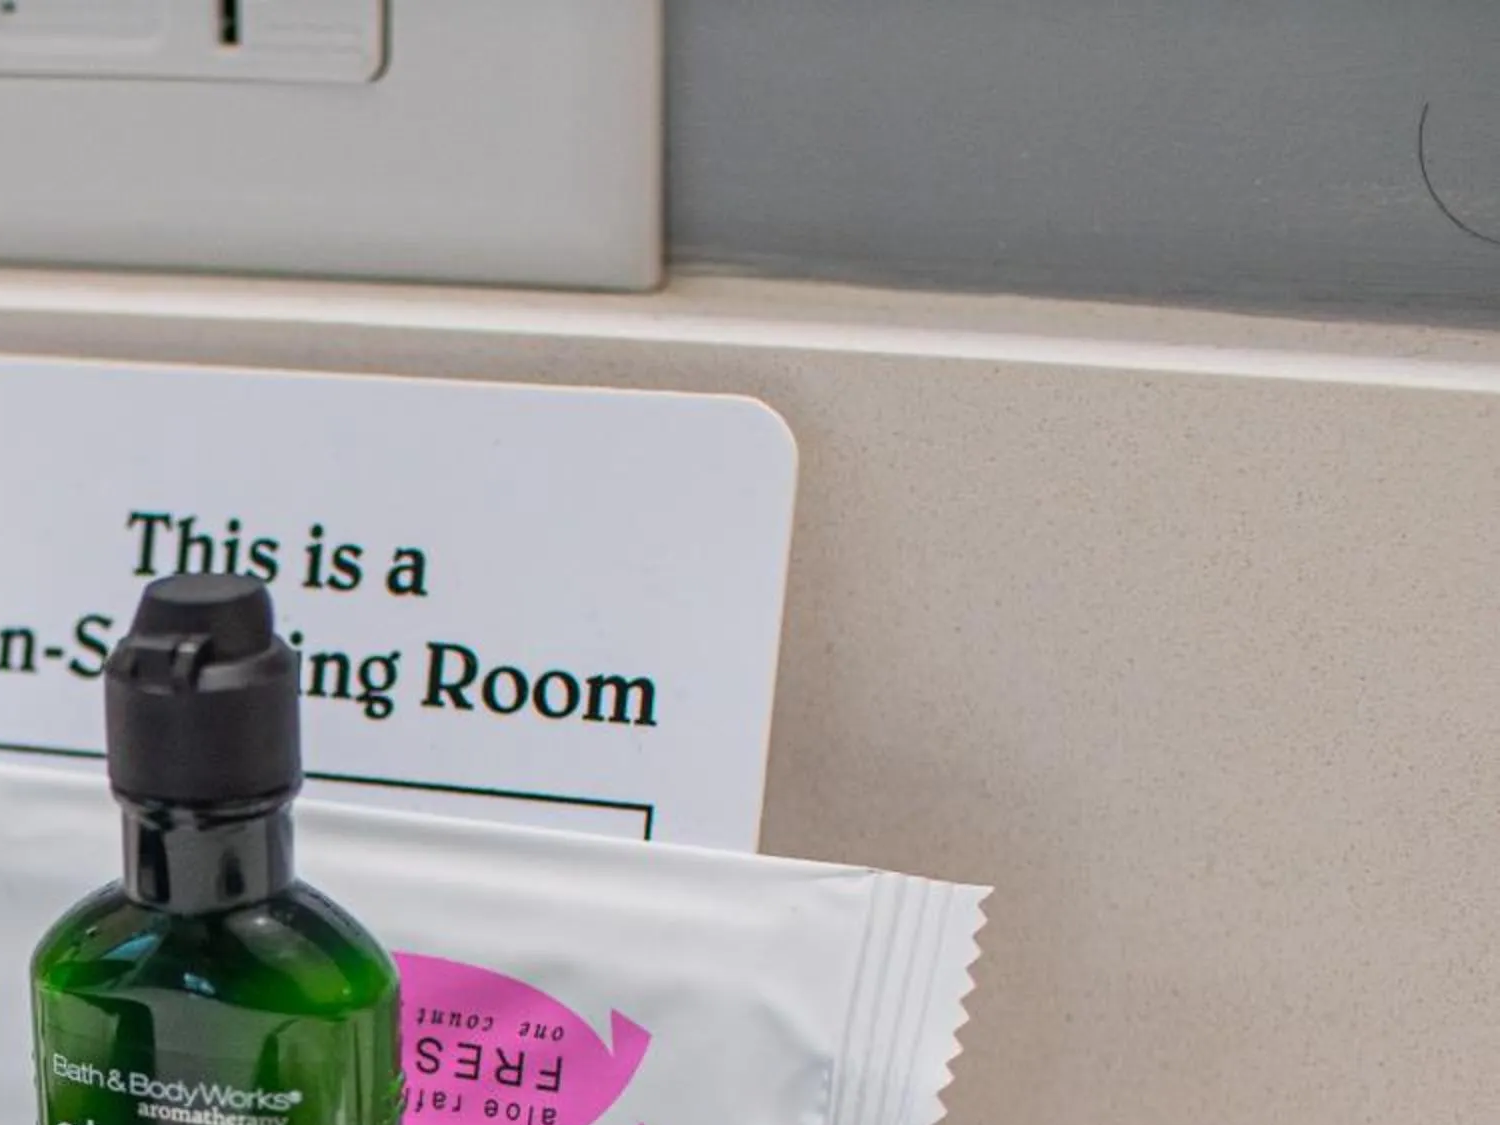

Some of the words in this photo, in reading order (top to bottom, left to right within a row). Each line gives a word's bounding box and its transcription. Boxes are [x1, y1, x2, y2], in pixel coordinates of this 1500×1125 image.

[126, 510, 279, 584] This
[302, 523, 364, 591] is
[386, 545, 428, 598] a
[420, 641, 658, 727] Room
[417, 1008, 494, 1031] count
[519, 1022, 565, 1041] one
[52, 1053, 104, 1089] Bath
[106, 1069, 127, 1094] &
[129, 1072, 199, 1107] Body
[416, 1036, 563, 1092] FRES
